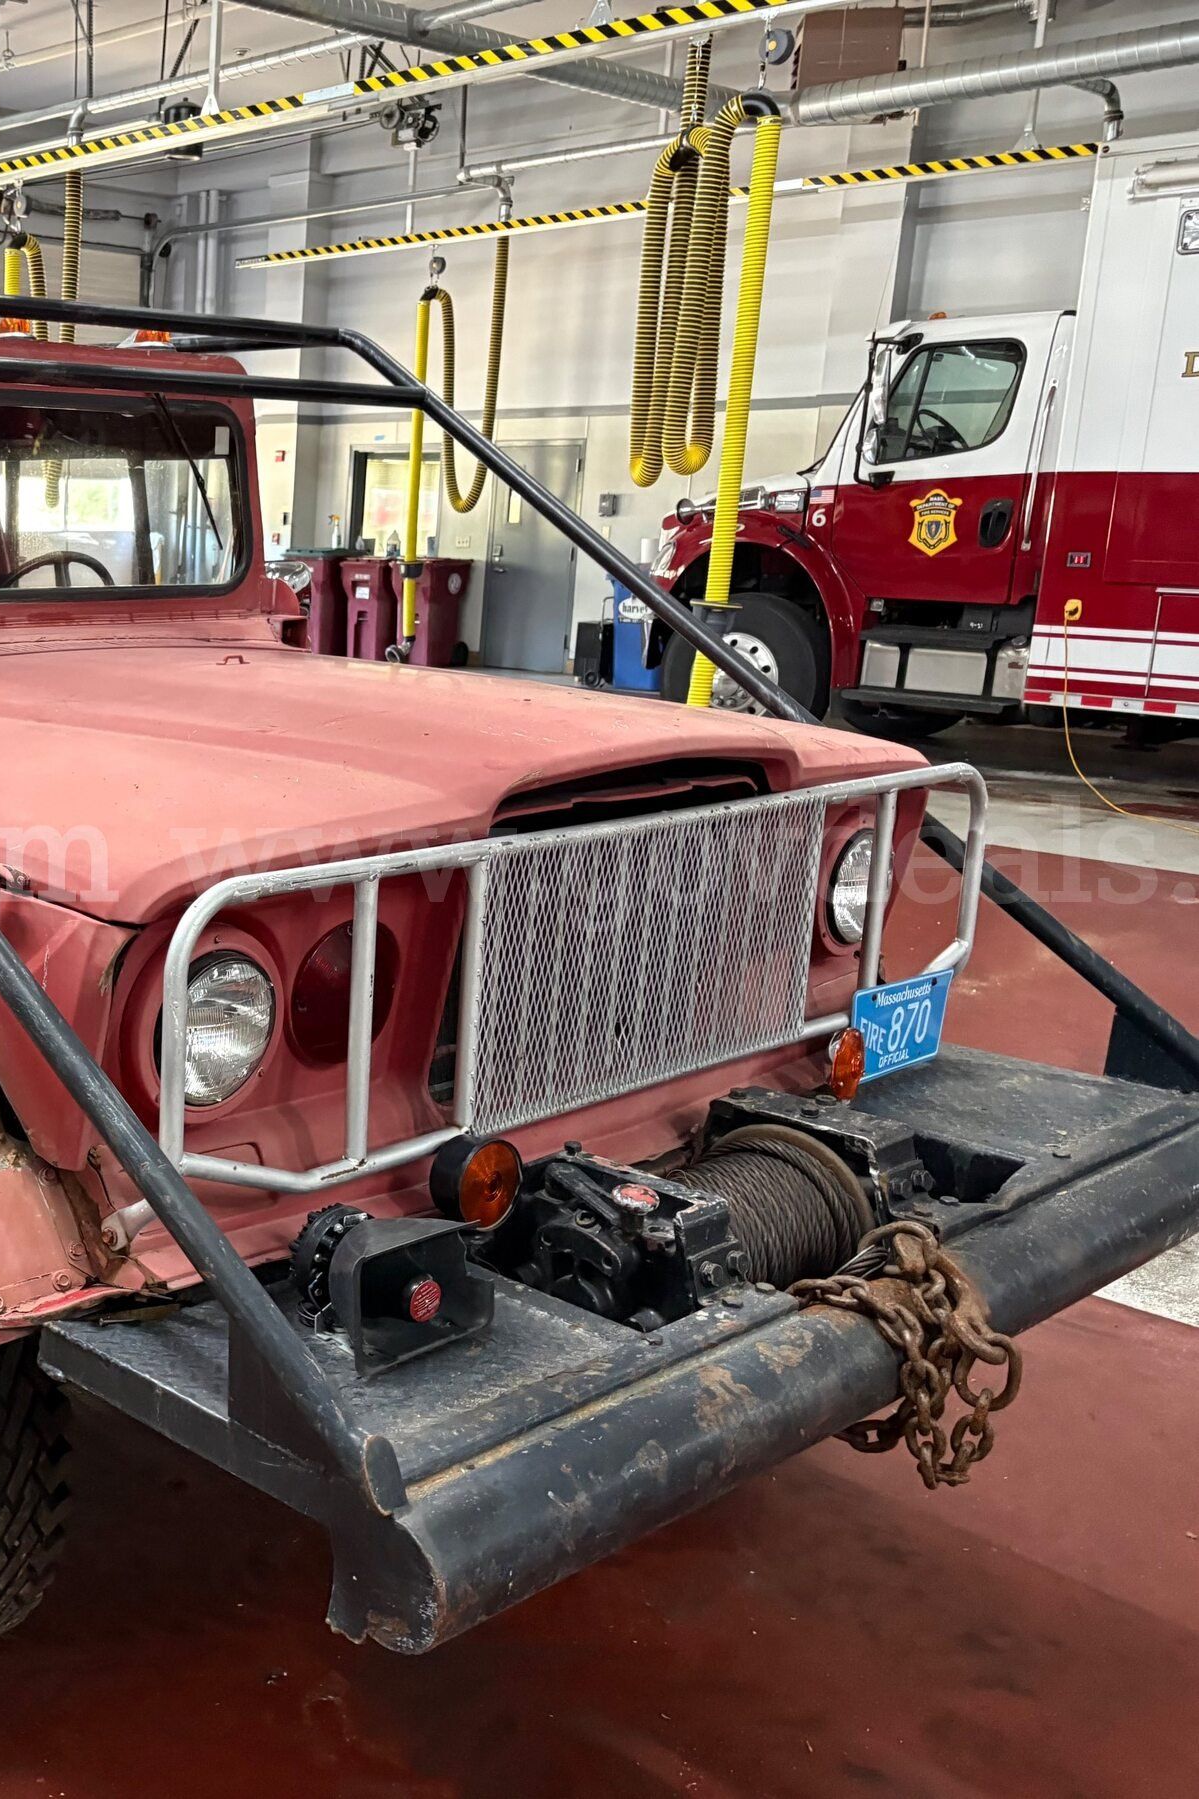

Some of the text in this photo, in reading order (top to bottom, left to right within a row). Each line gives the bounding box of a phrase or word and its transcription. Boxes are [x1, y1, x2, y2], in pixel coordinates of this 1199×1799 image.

[811, 508, 827, 527] 6
[875, 983, 932, 1008] Massachusetts
[887, 998, 931, 1053] 870
[878, 1048, 909, 1069] OFFICIAL
